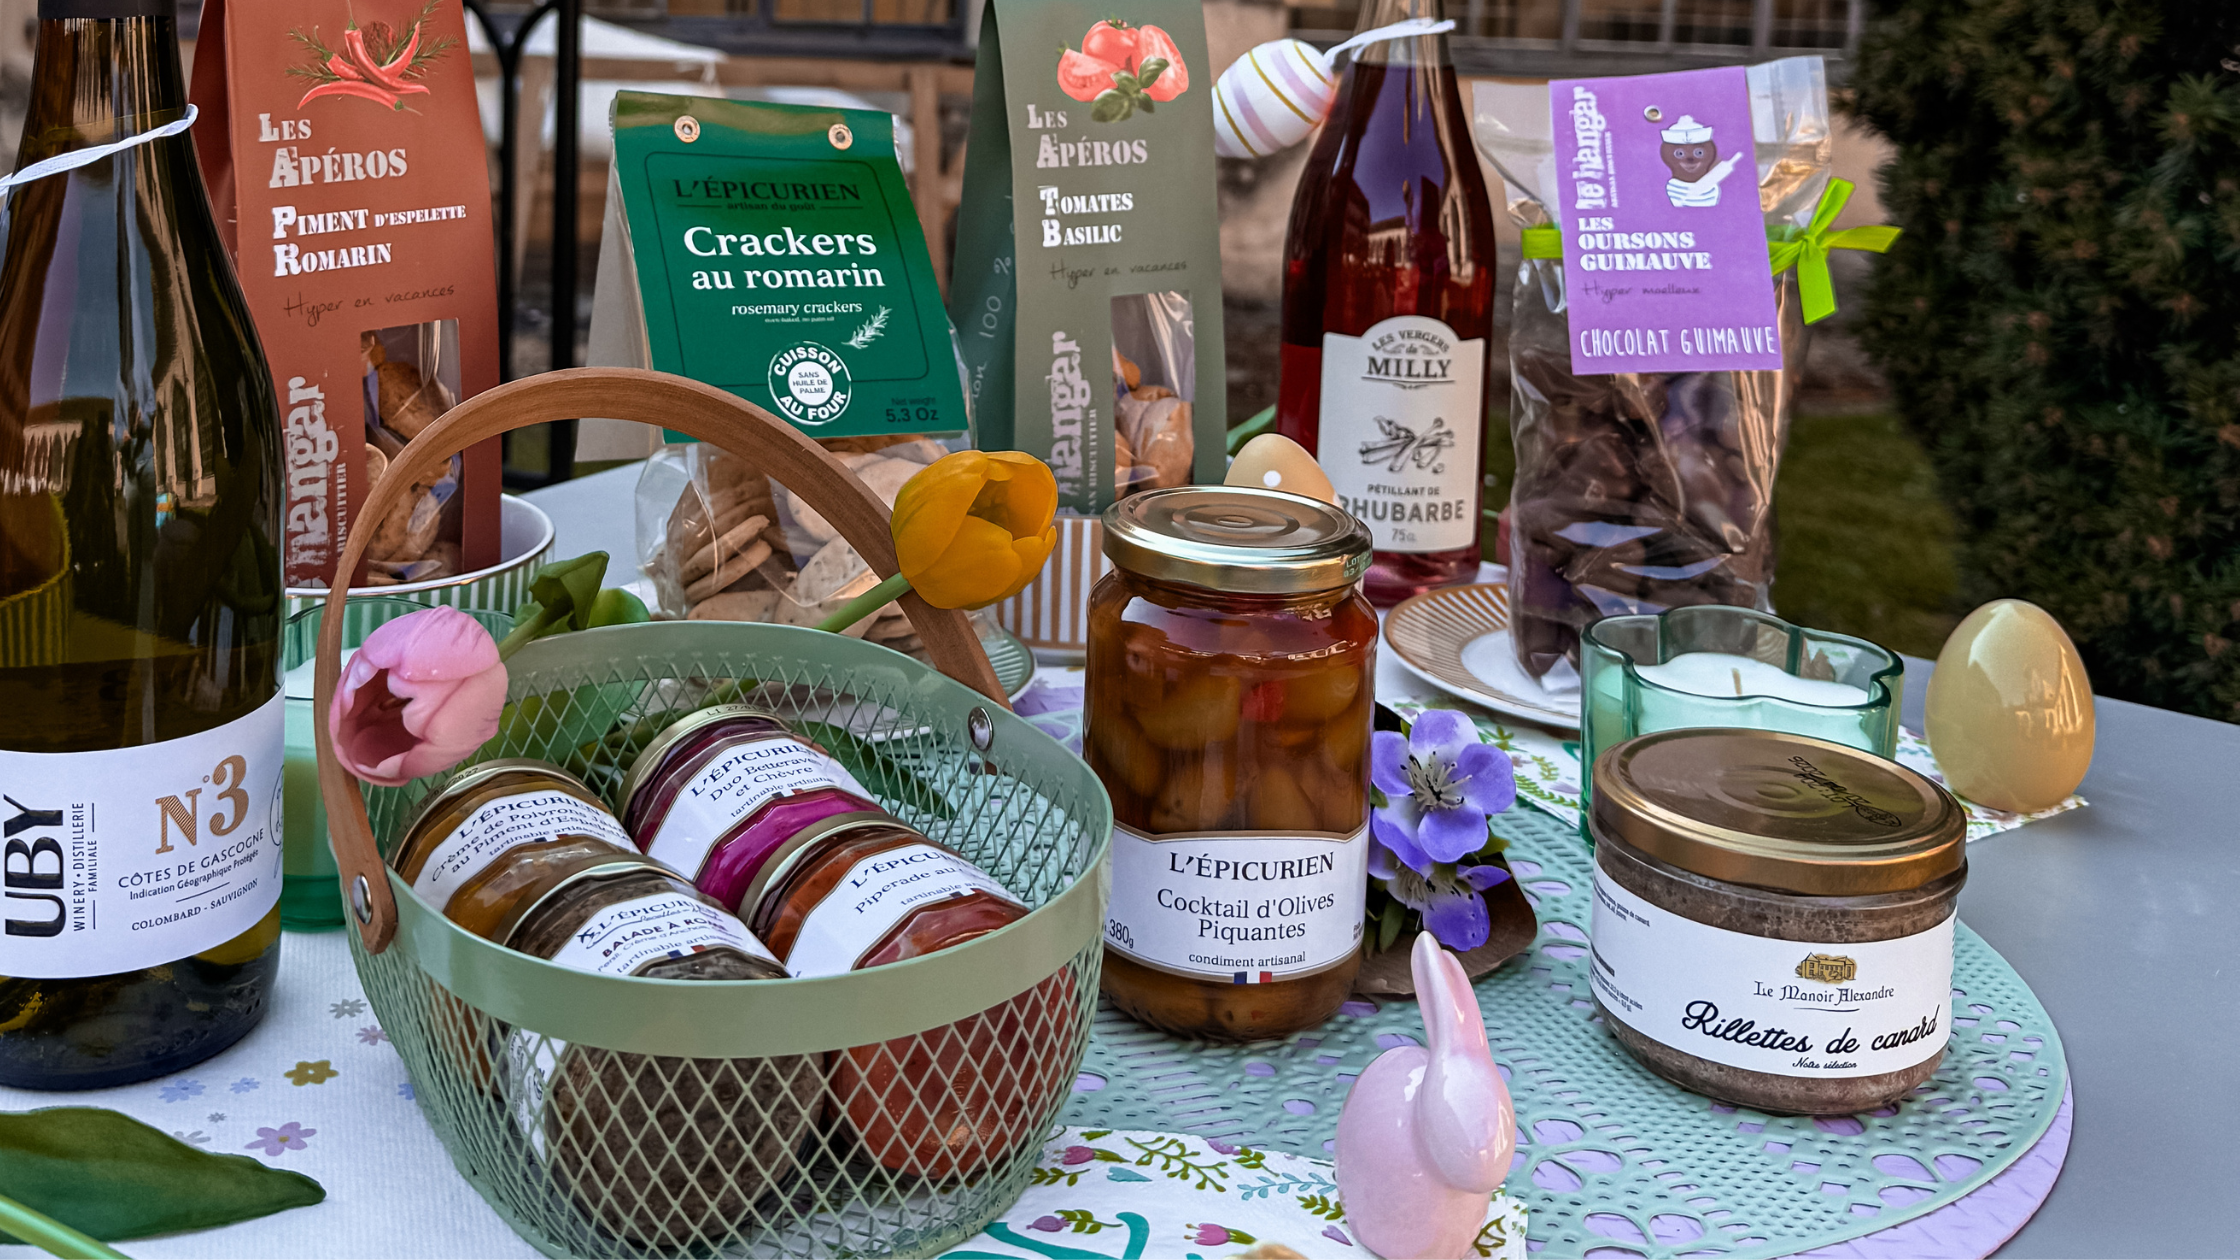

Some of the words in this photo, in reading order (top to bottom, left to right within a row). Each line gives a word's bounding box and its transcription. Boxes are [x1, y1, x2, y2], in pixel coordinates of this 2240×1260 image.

[258, 113, 312, 142] LES
[1027, 104, 1067, 129] LES
[1036, 134, 1148, 168] APÉROS
[269, 146, 407, 188] APÉROS
[673, 176, 861, 201] L'ÉPICURIEN
[1038, 185, 1133, 216] TOMATES
[272, 206, 369, 239] PIMENT
[374, 205, 466, 227] D'ESPELETTE
[727, 201, 768, 210] artisan
[772, 201, 786, 210] du
[789, 202, 816, 213] goût
[1042, 218, 1122, 247] BASILIC
[1578, 217, 1614, 231] LES
[684, 226, 877, 257] Crackers
[1578, 232, 1696, 250] OURSONS
[273, 243, 391, 277] ROMARIN
[1580, 252, 1713, 271] GUIMAUVE
[692, 271, 736, 289] au
[743, 262, 886, 289] romarin
[283, 291, 343, 327] Hyper
[354, 298, 374, 308] en
[385, 285, 455, 304] vacances
[979, 296, 1001, 338] 100
[993, 256, 1012, 275] %
[1581, 280, 1632, 304] Hyper
[732, 304, 800, 316] rosemary
[803, 300, 863, 313] crackers
[1371, 333, 1394, 351] LES
[1398, 330, 1450, 353] VERGERS
[1580, 328, 1670, 357] CHOCOLAT
[1680, 327, 1777, 355] GUIMAUVE
[774, 346, 842, 376] CUISSON
[1367, 356, 1451, 378] MILLY
[780, 395, 804, 416] AU
[808, 391, 847, 419] FOUR
[886, 408, 911, 422] 5.3
[916, 407, 939, 421] Oz
[1367, 484, 1425, 495] PÉTILLANT
[1428, 487, 1440, 495] DE
[710, 775, 742, 801] Duo
[736, 784, 752, 797] et
[754, 766, 813, 783] Chèvre
[731, 784, 784, 818] tartinable
[72, 803, 85, 870] DISTILLERIE
[432, 836, 480, 882] Crème
[484, 820, 505, 834] de
[509, 807, 587, 822] Poivrons
[452, 856, 470, 873] au
[474, 823, 534, 853] Piment
[489, 830, 549, 856] tartinable
[3, 793, 66, 938] UBY
[88, 840, 98, 892] FAMILIALE
[118, 867, 171, 889] CÔTES
[177, 861, 196, 876] DE
[200, 828, 264, 869] GASCOGNE
[851, 852, 966, 889] L'ÉPICU
[1169, 851, 1334, 881] L'ÉPICURIEN
[130, 884, 175, 900] Indication
[177, 864, 231, 891] Géographique
[233, 849, 259, 872] Protégée
[131, 906, 202, 931] COLOMBARD
[210, 878, 258, 910] SAUVIGNON
[855, 872, 931, 914] Piperade
[935, 867, 956, 875] au
[900, 884, 962, 906] tartinable
[1157, 888, 1249, 919] Cocktail
[1257, 892, 1334, 919] d'Olives
[73, 883, 85, 932] WINERY
[599, 900, 718, 931] L'ÉPICUR
[602, 925, 663, 958] BALADE
[667, 921, 681, 930] À
[683, 917, 729, 932] RO
[1198, 918, 1306, 945] Piquantes
[617, 941, 682, 973] tartinable
[1188, 952, 1254, 967] condiment
[1258, 951, 1306, 967] artisanal
[1753, 980, 1773, 997] Le
[1779, 984, 1834, 1003] Manoir
[1834, 986, 1895, 1006] Alexandre
[1681, 1000, 1813, 1053] Rillettes
[1826, 1027, 1860, 1054] de
[1871, 1004, 1940, 1051] canard
[1792, 1057, 1820, 1069] Notre
[1823, 1060, 1858, 1069] sélection
